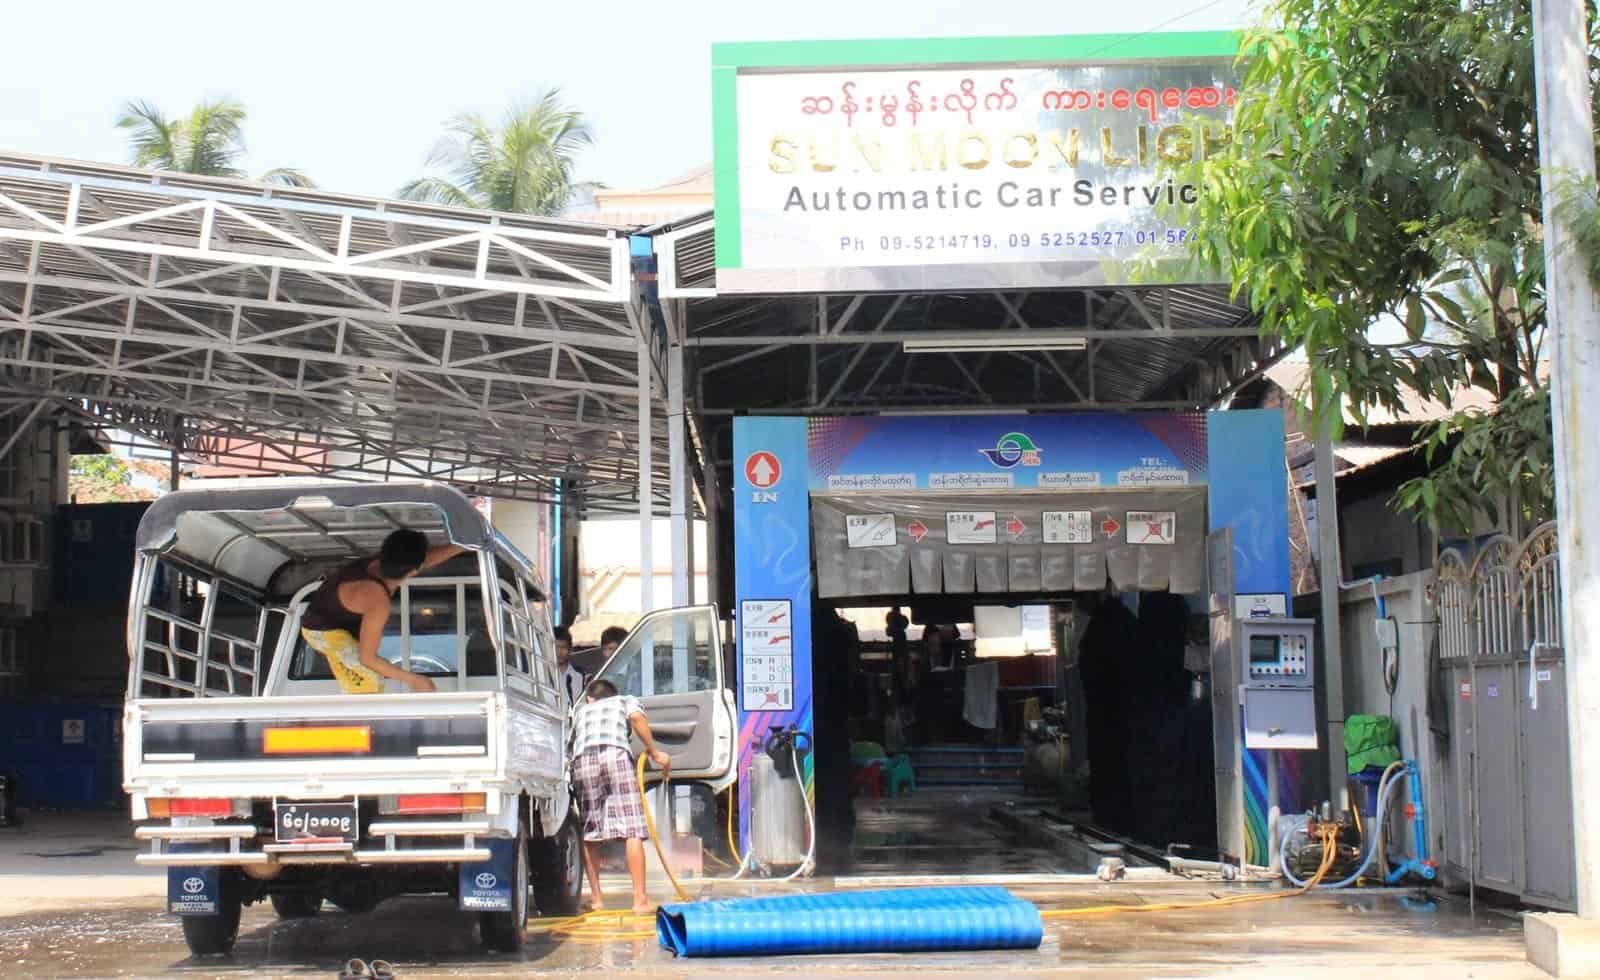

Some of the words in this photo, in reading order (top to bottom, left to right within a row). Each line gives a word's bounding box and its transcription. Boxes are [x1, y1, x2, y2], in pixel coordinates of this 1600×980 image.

[767, 130, 882, 174] SUN
[910, 126, 1080, 172] MOON
[1101, 124, 1233, 167] LIGH
[783, 182, 983, 212] Automatic
[997, 180, 1062, 209] Car
[1073, 178, 1210, 206] Servic
[840, 236, 865, 251] Ph
[1008, 233, 1030, 248] 09
[1135, 231, 1155, 244] 01
[751, 492, 777, 503] IN
